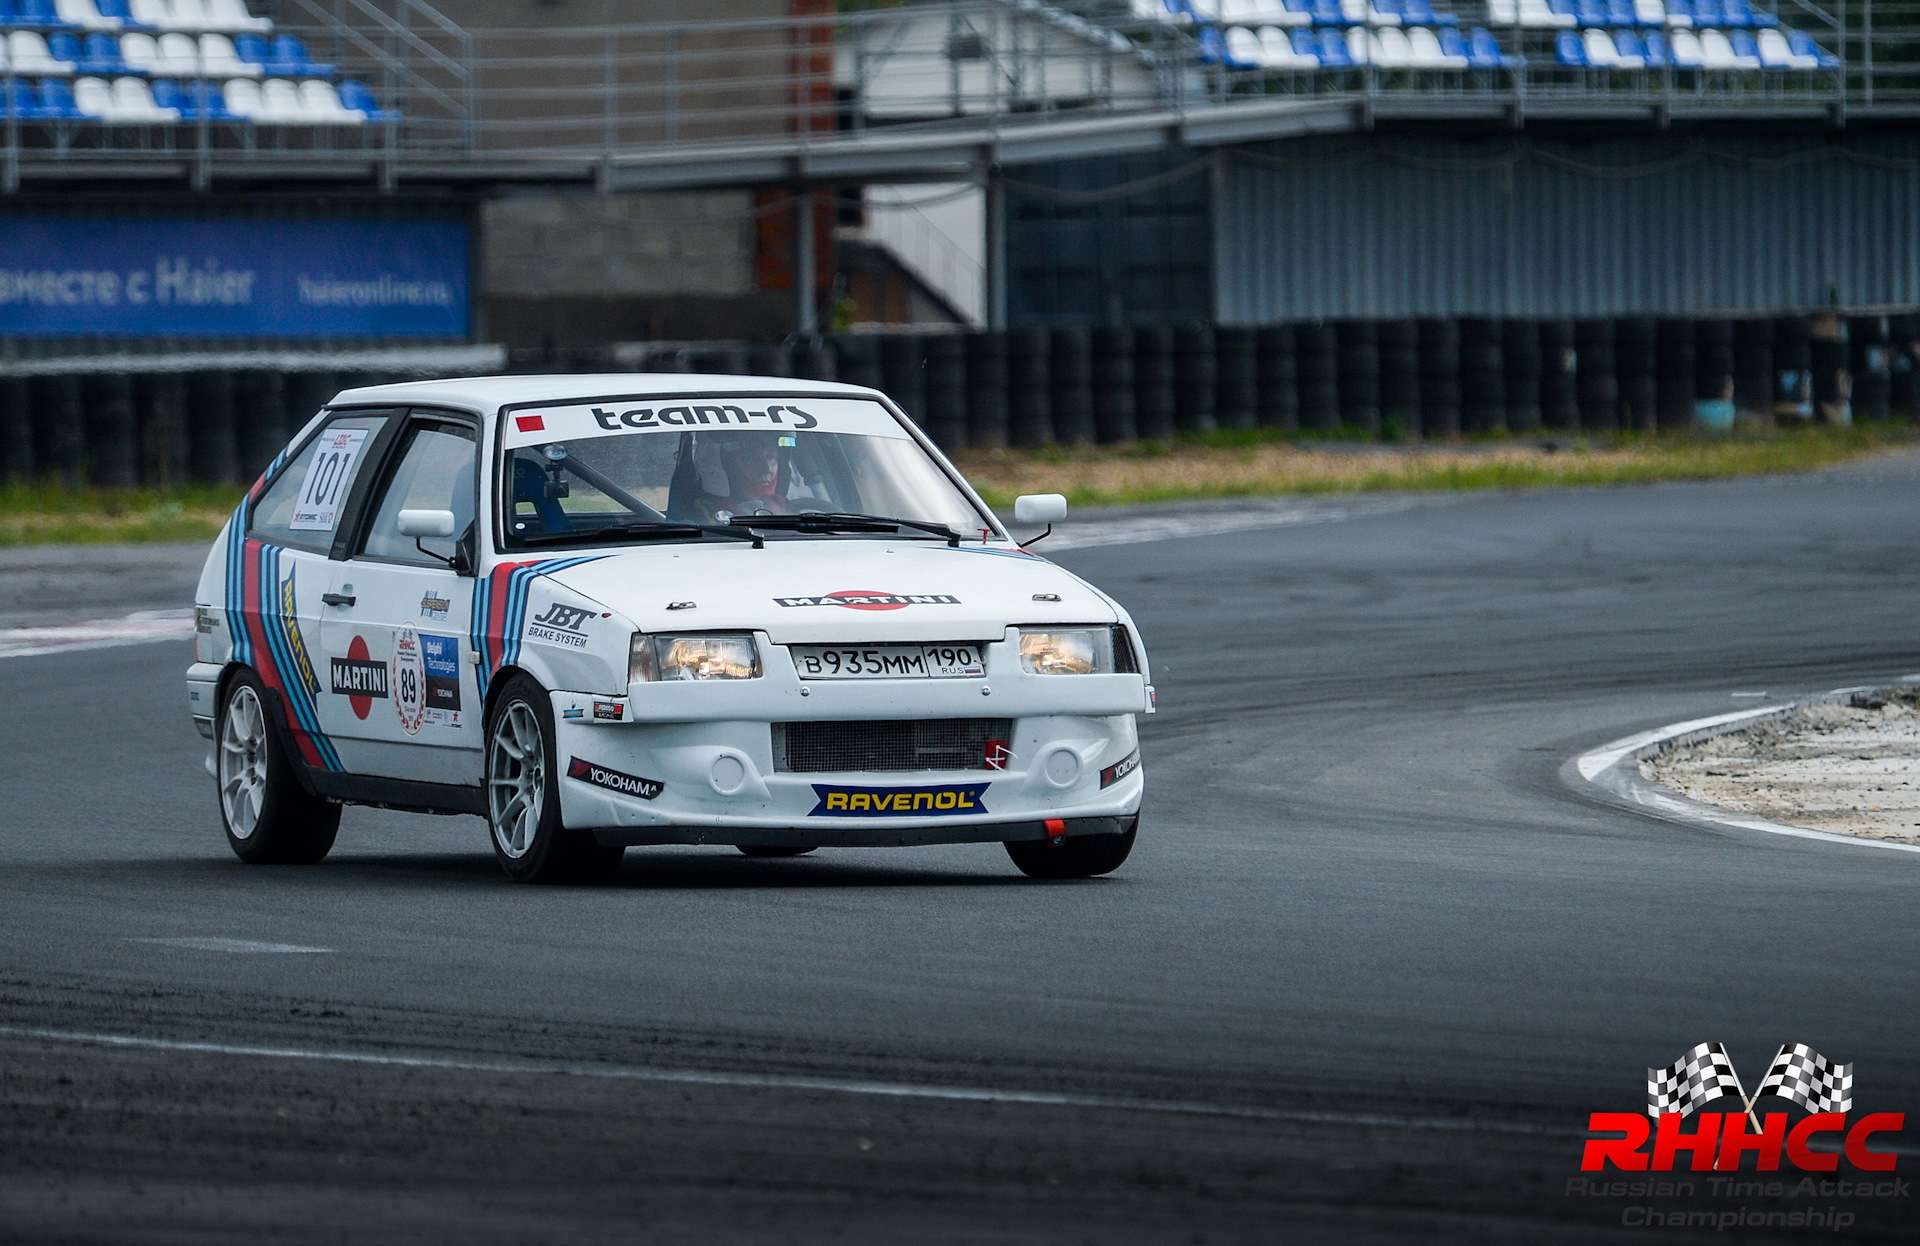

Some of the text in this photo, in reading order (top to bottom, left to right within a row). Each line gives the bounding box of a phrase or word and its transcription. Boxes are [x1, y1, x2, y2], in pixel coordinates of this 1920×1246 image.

[155, 256, 256, 305] Haier
[305, 452, 351, 506] 101
[783, 596, 951, 606] MARTINI
[534, 603, 597, 630] JBT
[284, 579, 315, 694] RAVENOL
[529, 627, 587, 648] BRAKE SYSTEM
[928, 648, 971, 666] 190
[333, 665, 386, 692] MARTINI
[401, 668, 416, 703] 89
[827, 791, 974, 810] RAVENOL
